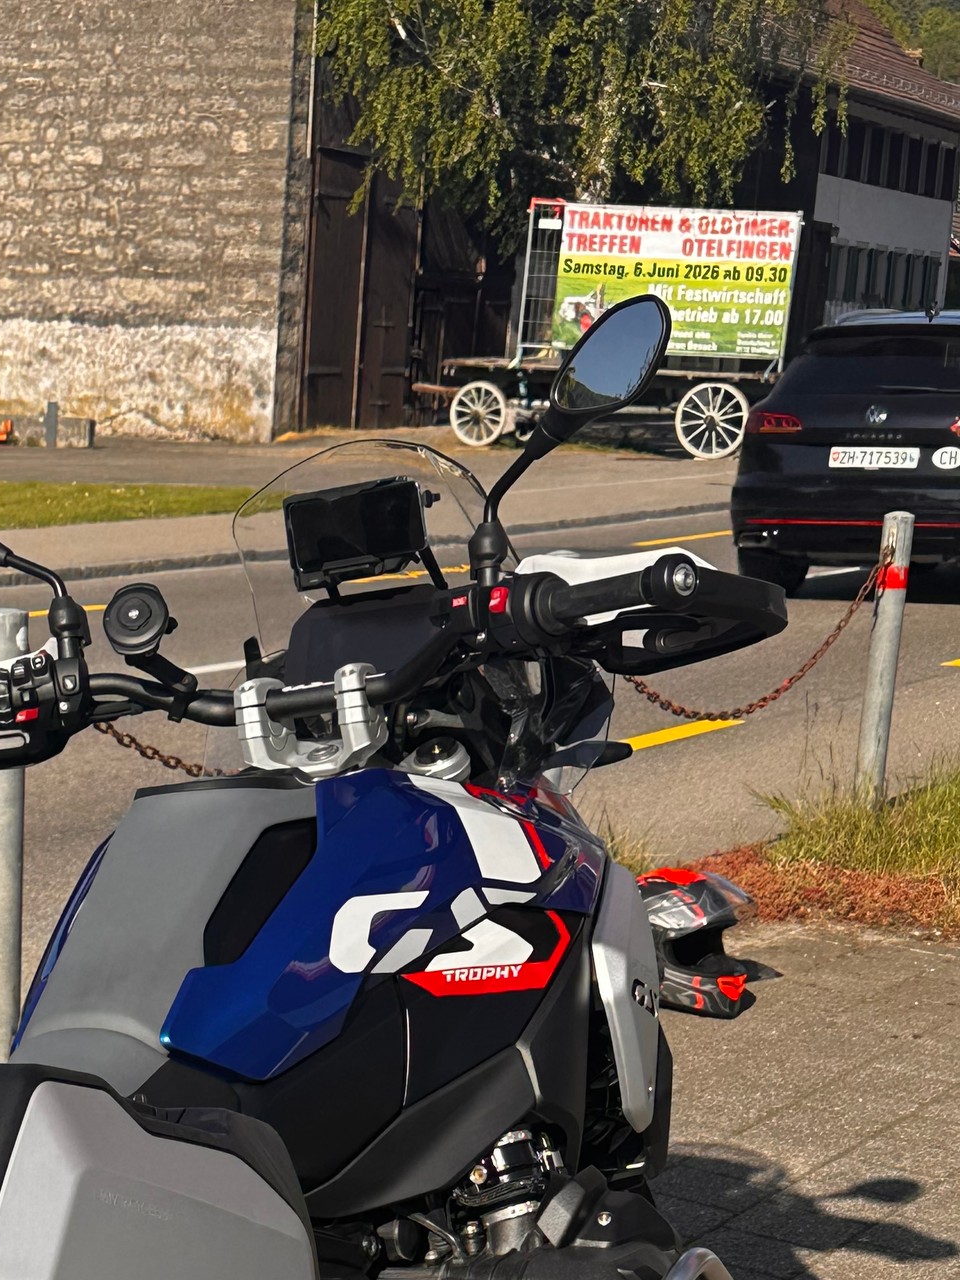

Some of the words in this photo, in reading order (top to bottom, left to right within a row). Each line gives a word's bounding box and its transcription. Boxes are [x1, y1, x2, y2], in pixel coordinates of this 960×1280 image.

[568, 210, 674, 232] TRAKTOREN
[678, 216, 692, 233] &
[566, 232, 642, 254] TREFFEN
[682, 238, 792, 260] OTELFINGEN
[684, 264, 720, 280] 2026
[723, 266, 741, 281] ab
[745, 266, 788, 282] 09.30
[647, 284, 674, 301] Mit
[677, 284, 787, 305] Festwirtschaft
[670, 305, 718, 323] betrieb
[722, 308, 739, 324] ab
[744, 309, 784, 326] 17.00
[940, 451, 958, 465] CH
[442, 964, 523, 983] TROPHY
